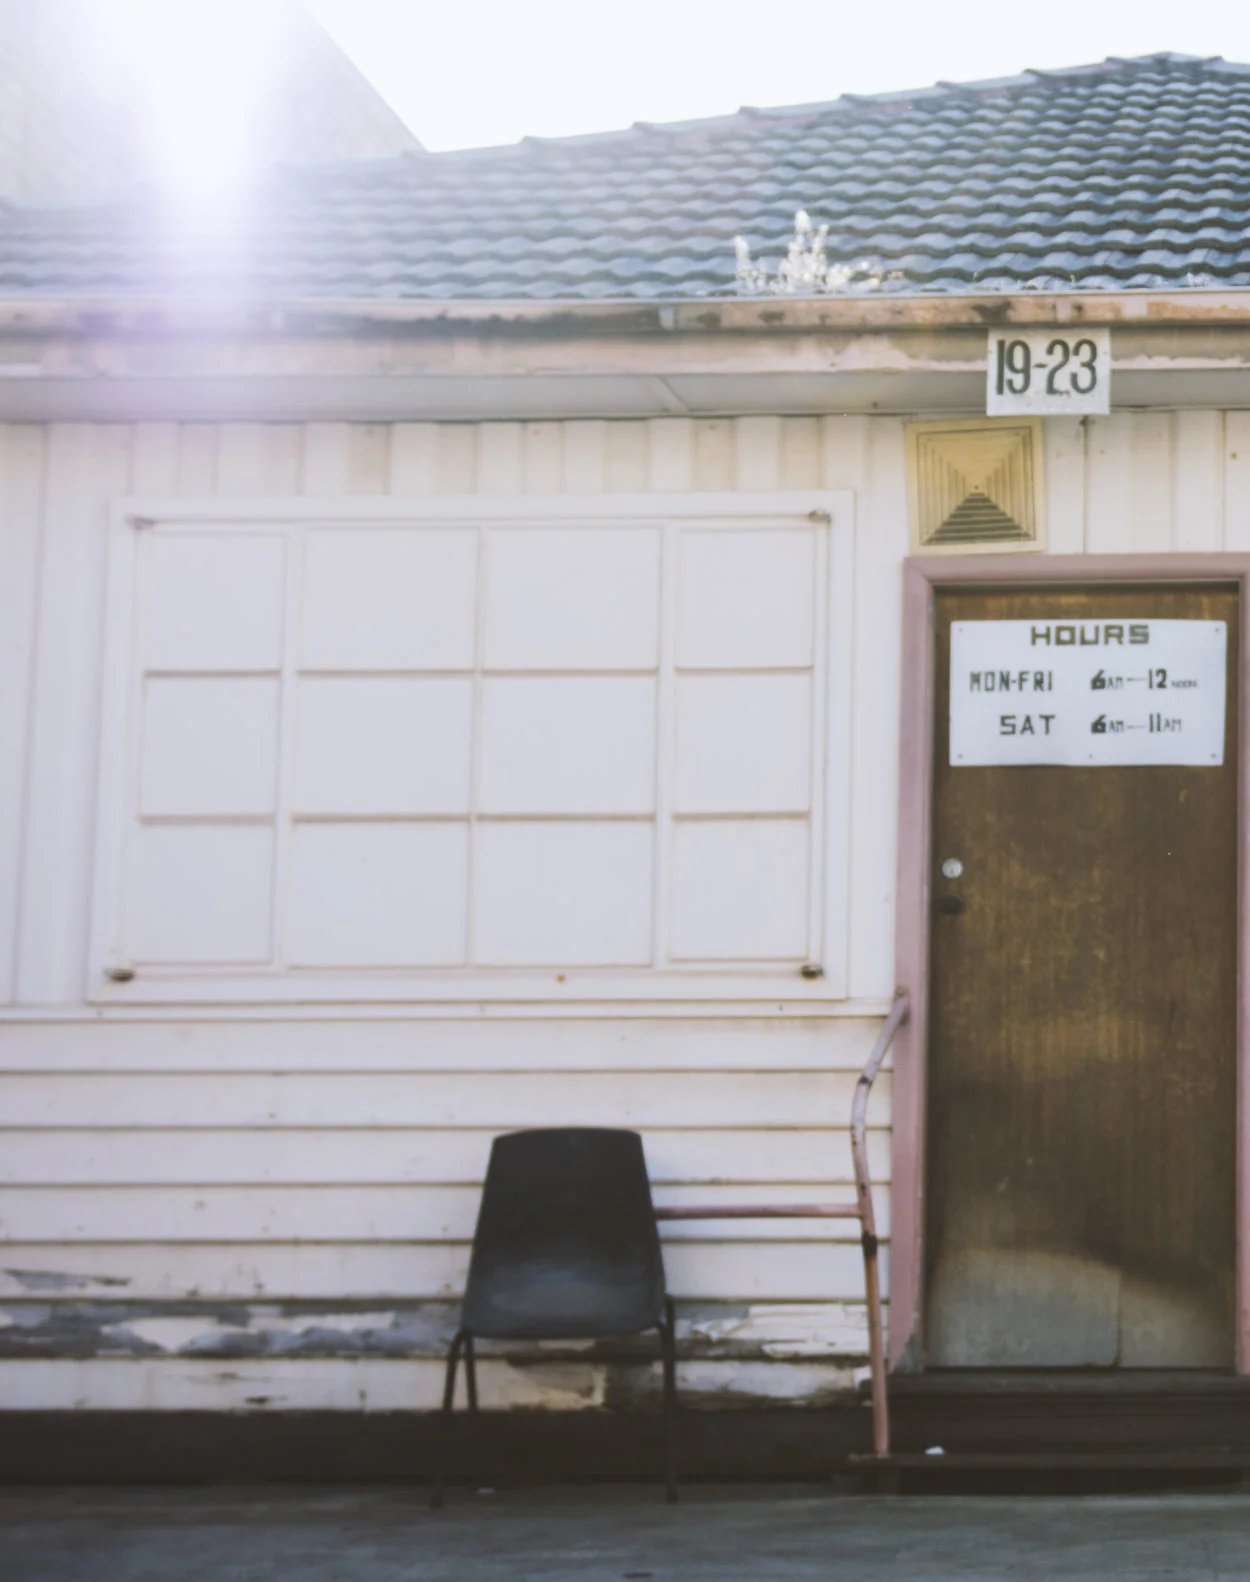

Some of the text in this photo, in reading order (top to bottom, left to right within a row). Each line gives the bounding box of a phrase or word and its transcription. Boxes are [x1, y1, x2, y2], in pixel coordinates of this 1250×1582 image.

[996, 338, 1097, 395] 19-23
[1031, 625, 1149, 646] HOURS
[969, 670, 1053, 692] MON-FRI
[1000, 714, 1055, 735] SAT
